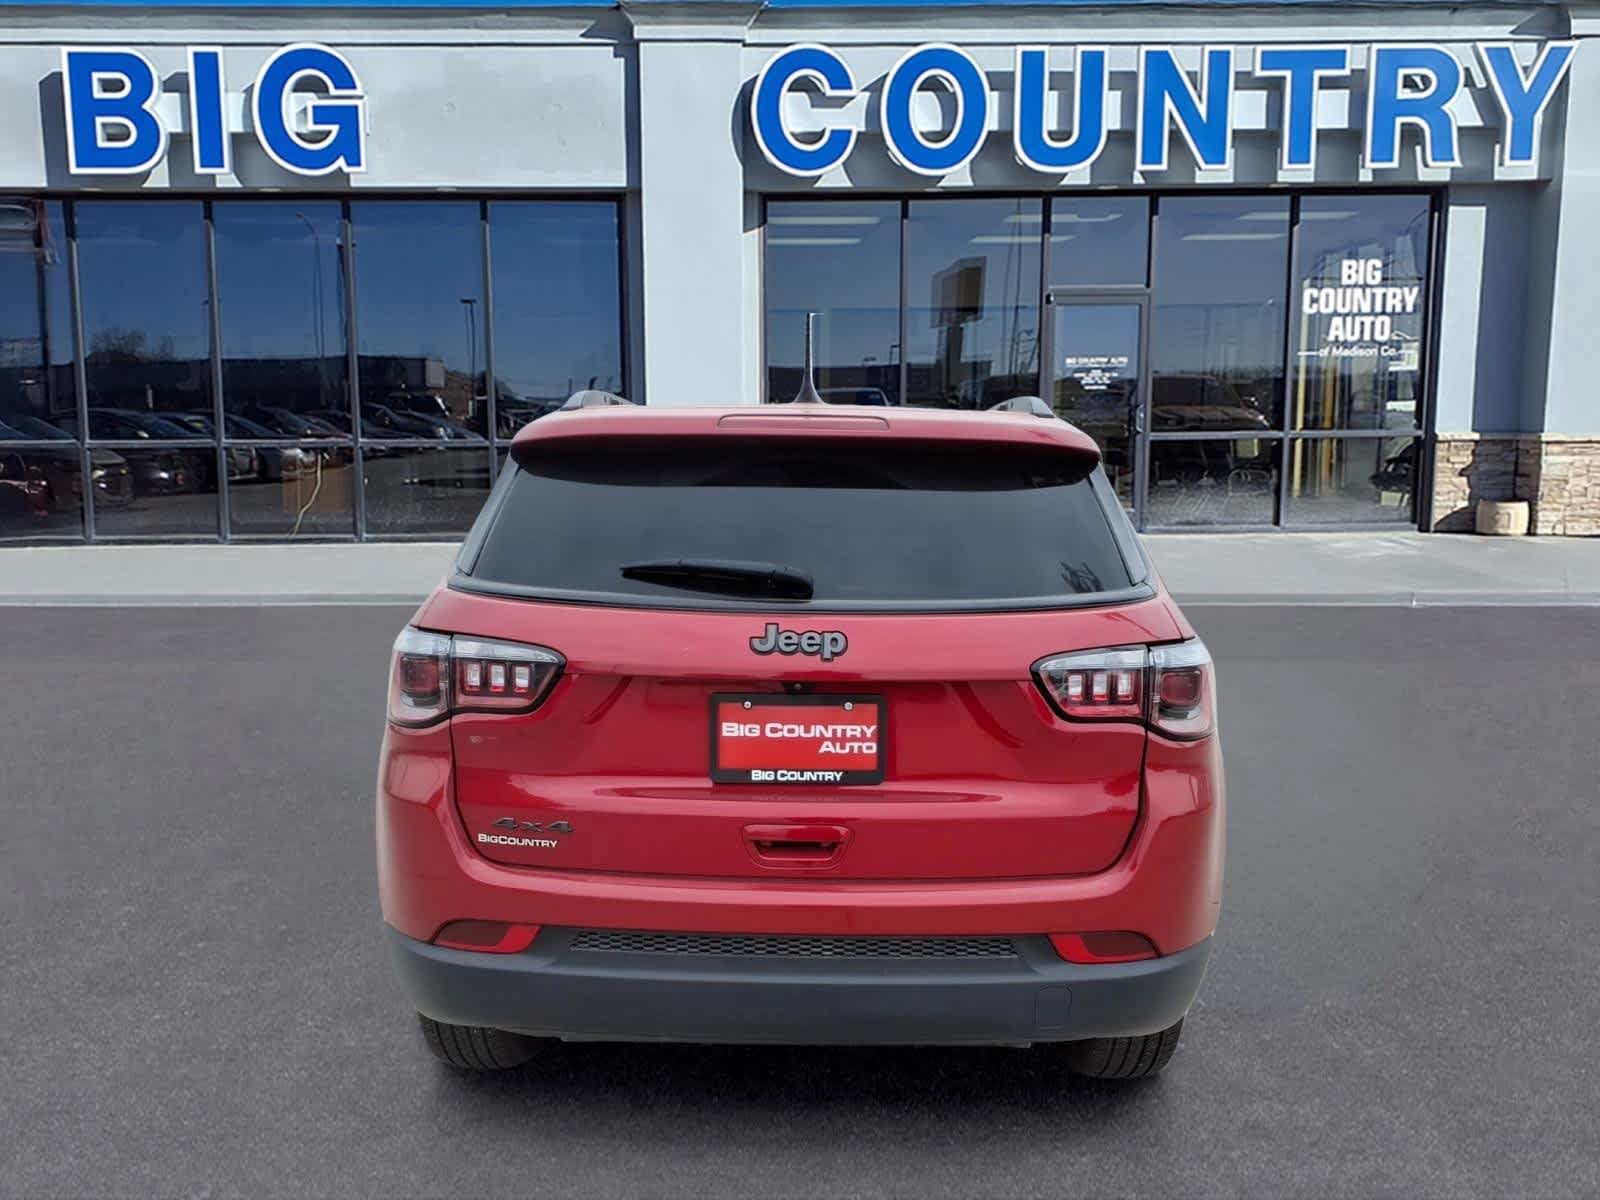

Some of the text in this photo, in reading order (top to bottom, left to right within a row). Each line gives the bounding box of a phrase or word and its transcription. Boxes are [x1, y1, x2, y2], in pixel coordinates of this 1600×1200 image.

[61, 42, 1575, 177] BIG COUNTRY
[1341, 259, 1382, 286] BIG
[1302, 287, 1419, 314] COUNTRY
[1327, 316, 1391, 342] AUTO
[1319, 346, 1329, 357] of
[1331, 346, 1378, 357] Madison
[750, 623, 848, 661] Jeep
[494, 817, 572, 833] 4x4
